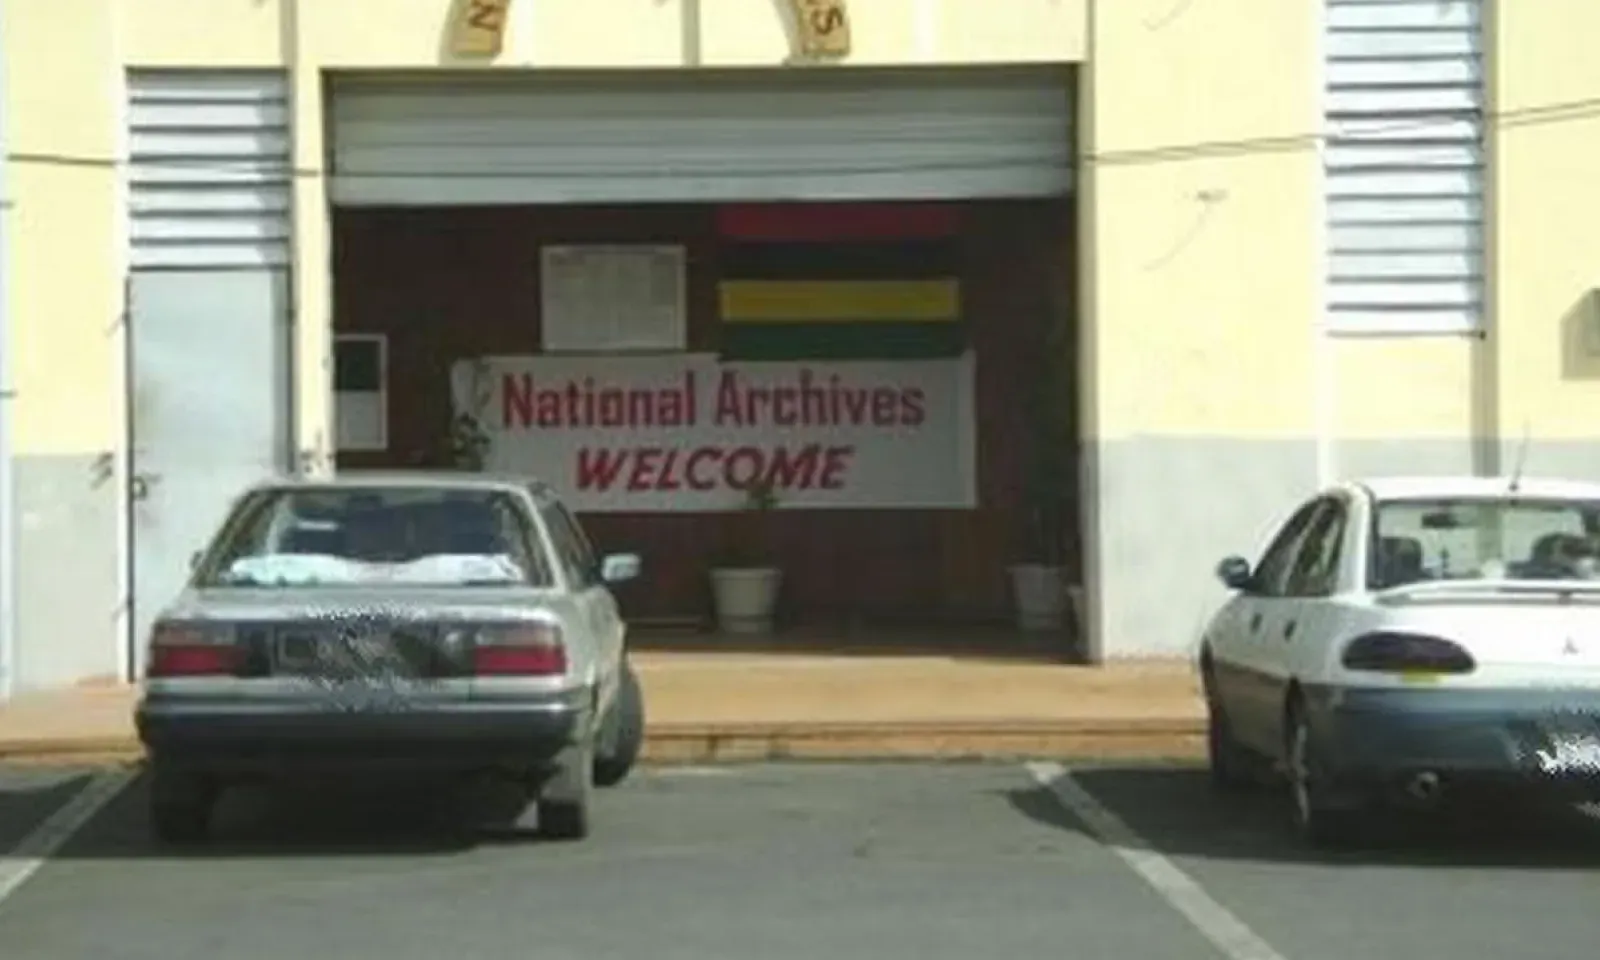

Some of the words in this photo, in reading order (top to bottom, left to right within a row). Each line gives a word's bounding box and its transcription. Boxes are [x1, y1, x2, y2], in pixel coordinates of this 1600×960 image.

[806, 0, 843, 36] S
[501, 370, 696, 428] National
[714, 369, 926, 426] Archives
[576, 444, 853, 491] WELCOME
